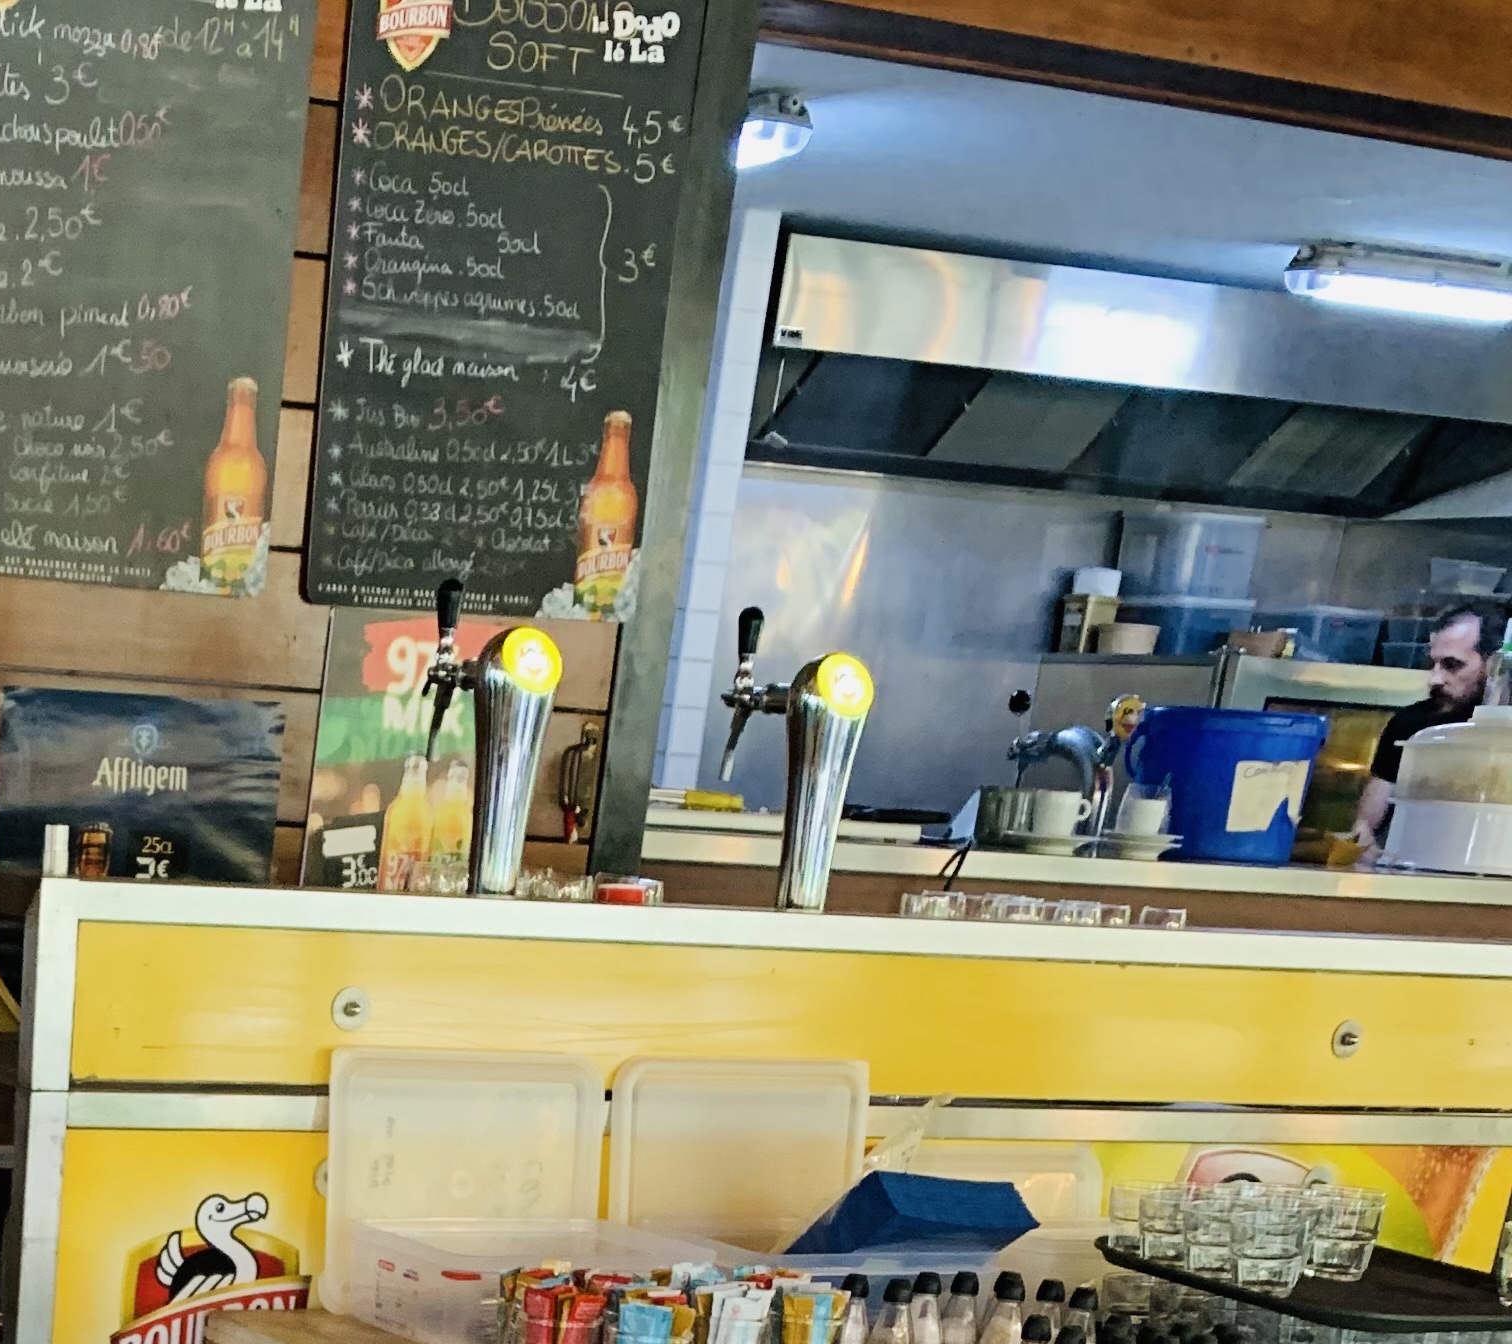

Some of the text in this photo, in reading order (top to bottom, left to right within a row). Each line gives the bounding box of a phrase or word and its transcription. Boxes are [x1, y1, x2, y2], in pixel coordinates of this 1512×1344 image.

[379, 5, 449, 34] BOURBON
[488, 31, 595, 75] SOFT
[380, 74, 520, 123] ORANGES
[91, 757, 188, 796] Affligem
